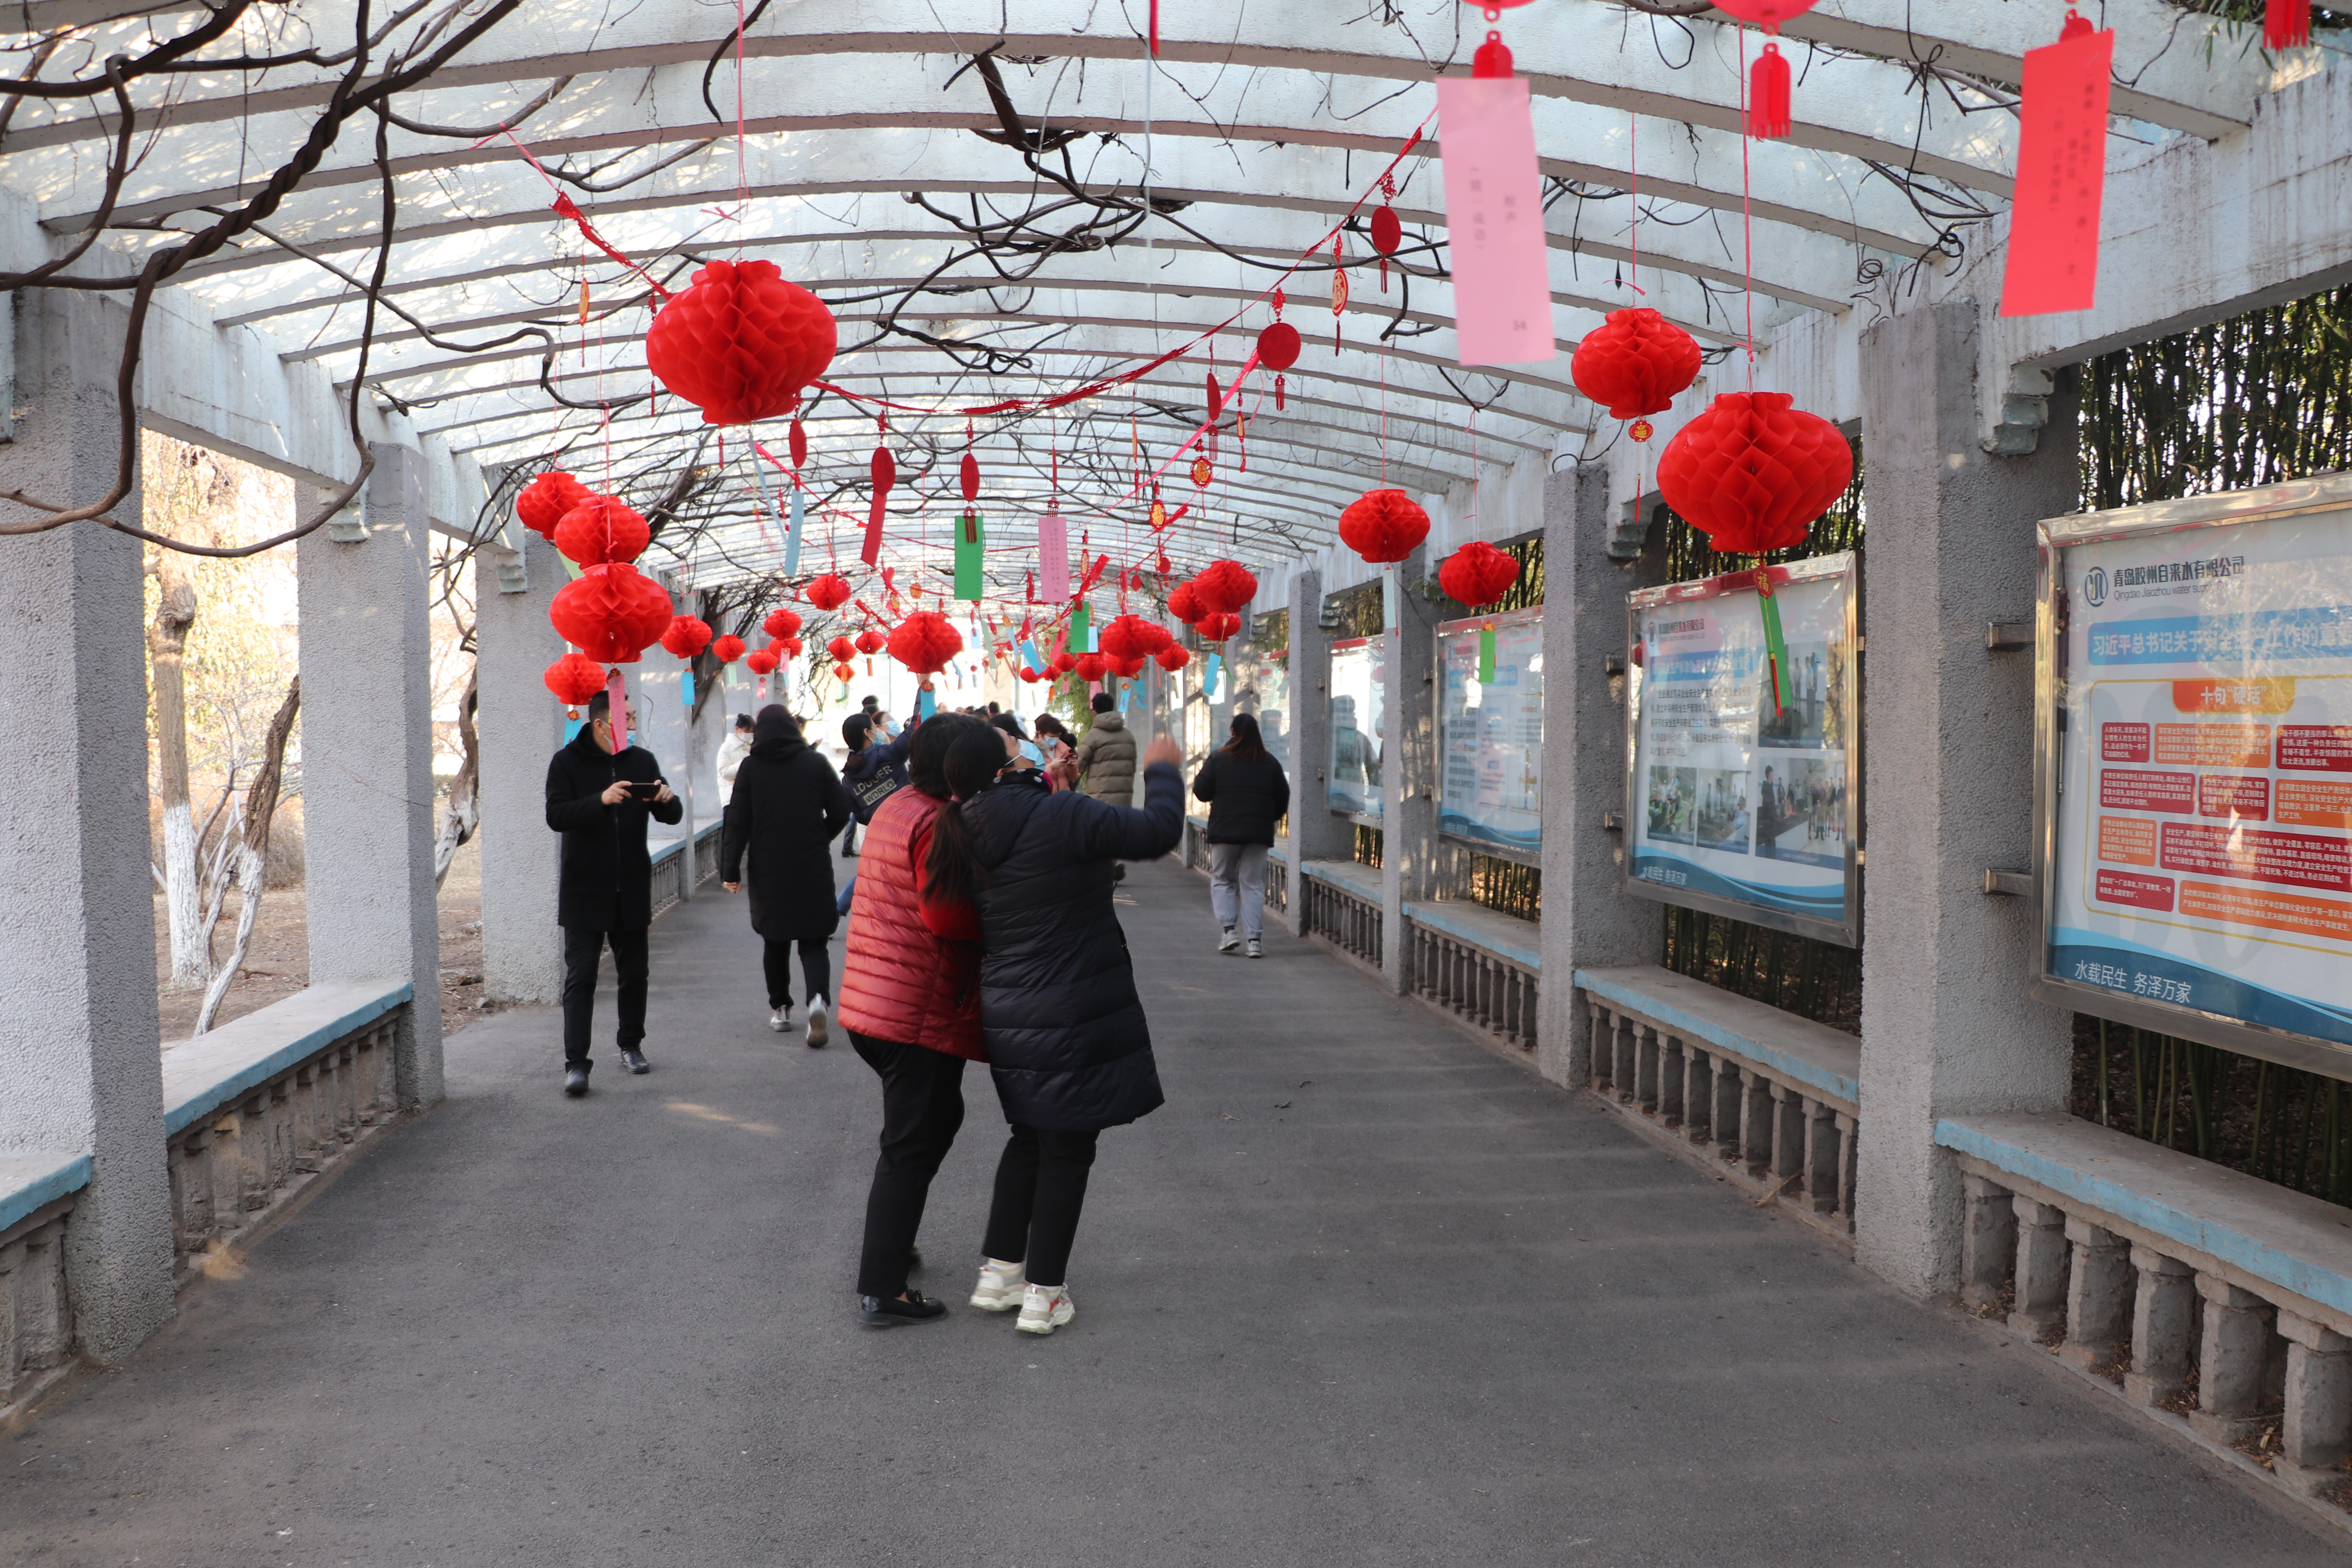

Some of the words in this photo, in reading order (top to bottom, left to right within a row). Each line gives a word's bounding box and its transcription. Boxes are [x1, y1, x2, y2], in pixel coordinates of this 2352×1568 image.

[2113, 556, 2244, 587] 青岛胶州自来水有限公司
[2114, 589, 2140, 601] Qingdao
[2142, 586, 2171, 597] Jiaozhou
[2172, 585, 2191, 595] water
[2201, 685, 2267, 705] 十句“硬话”
[2278, 783, 2352, 795] 必须建立健全安全生产责任体
[2074, 959, 2127, 989] 水载民生
[2133, 971, 2192, 1004] 务泽万家
